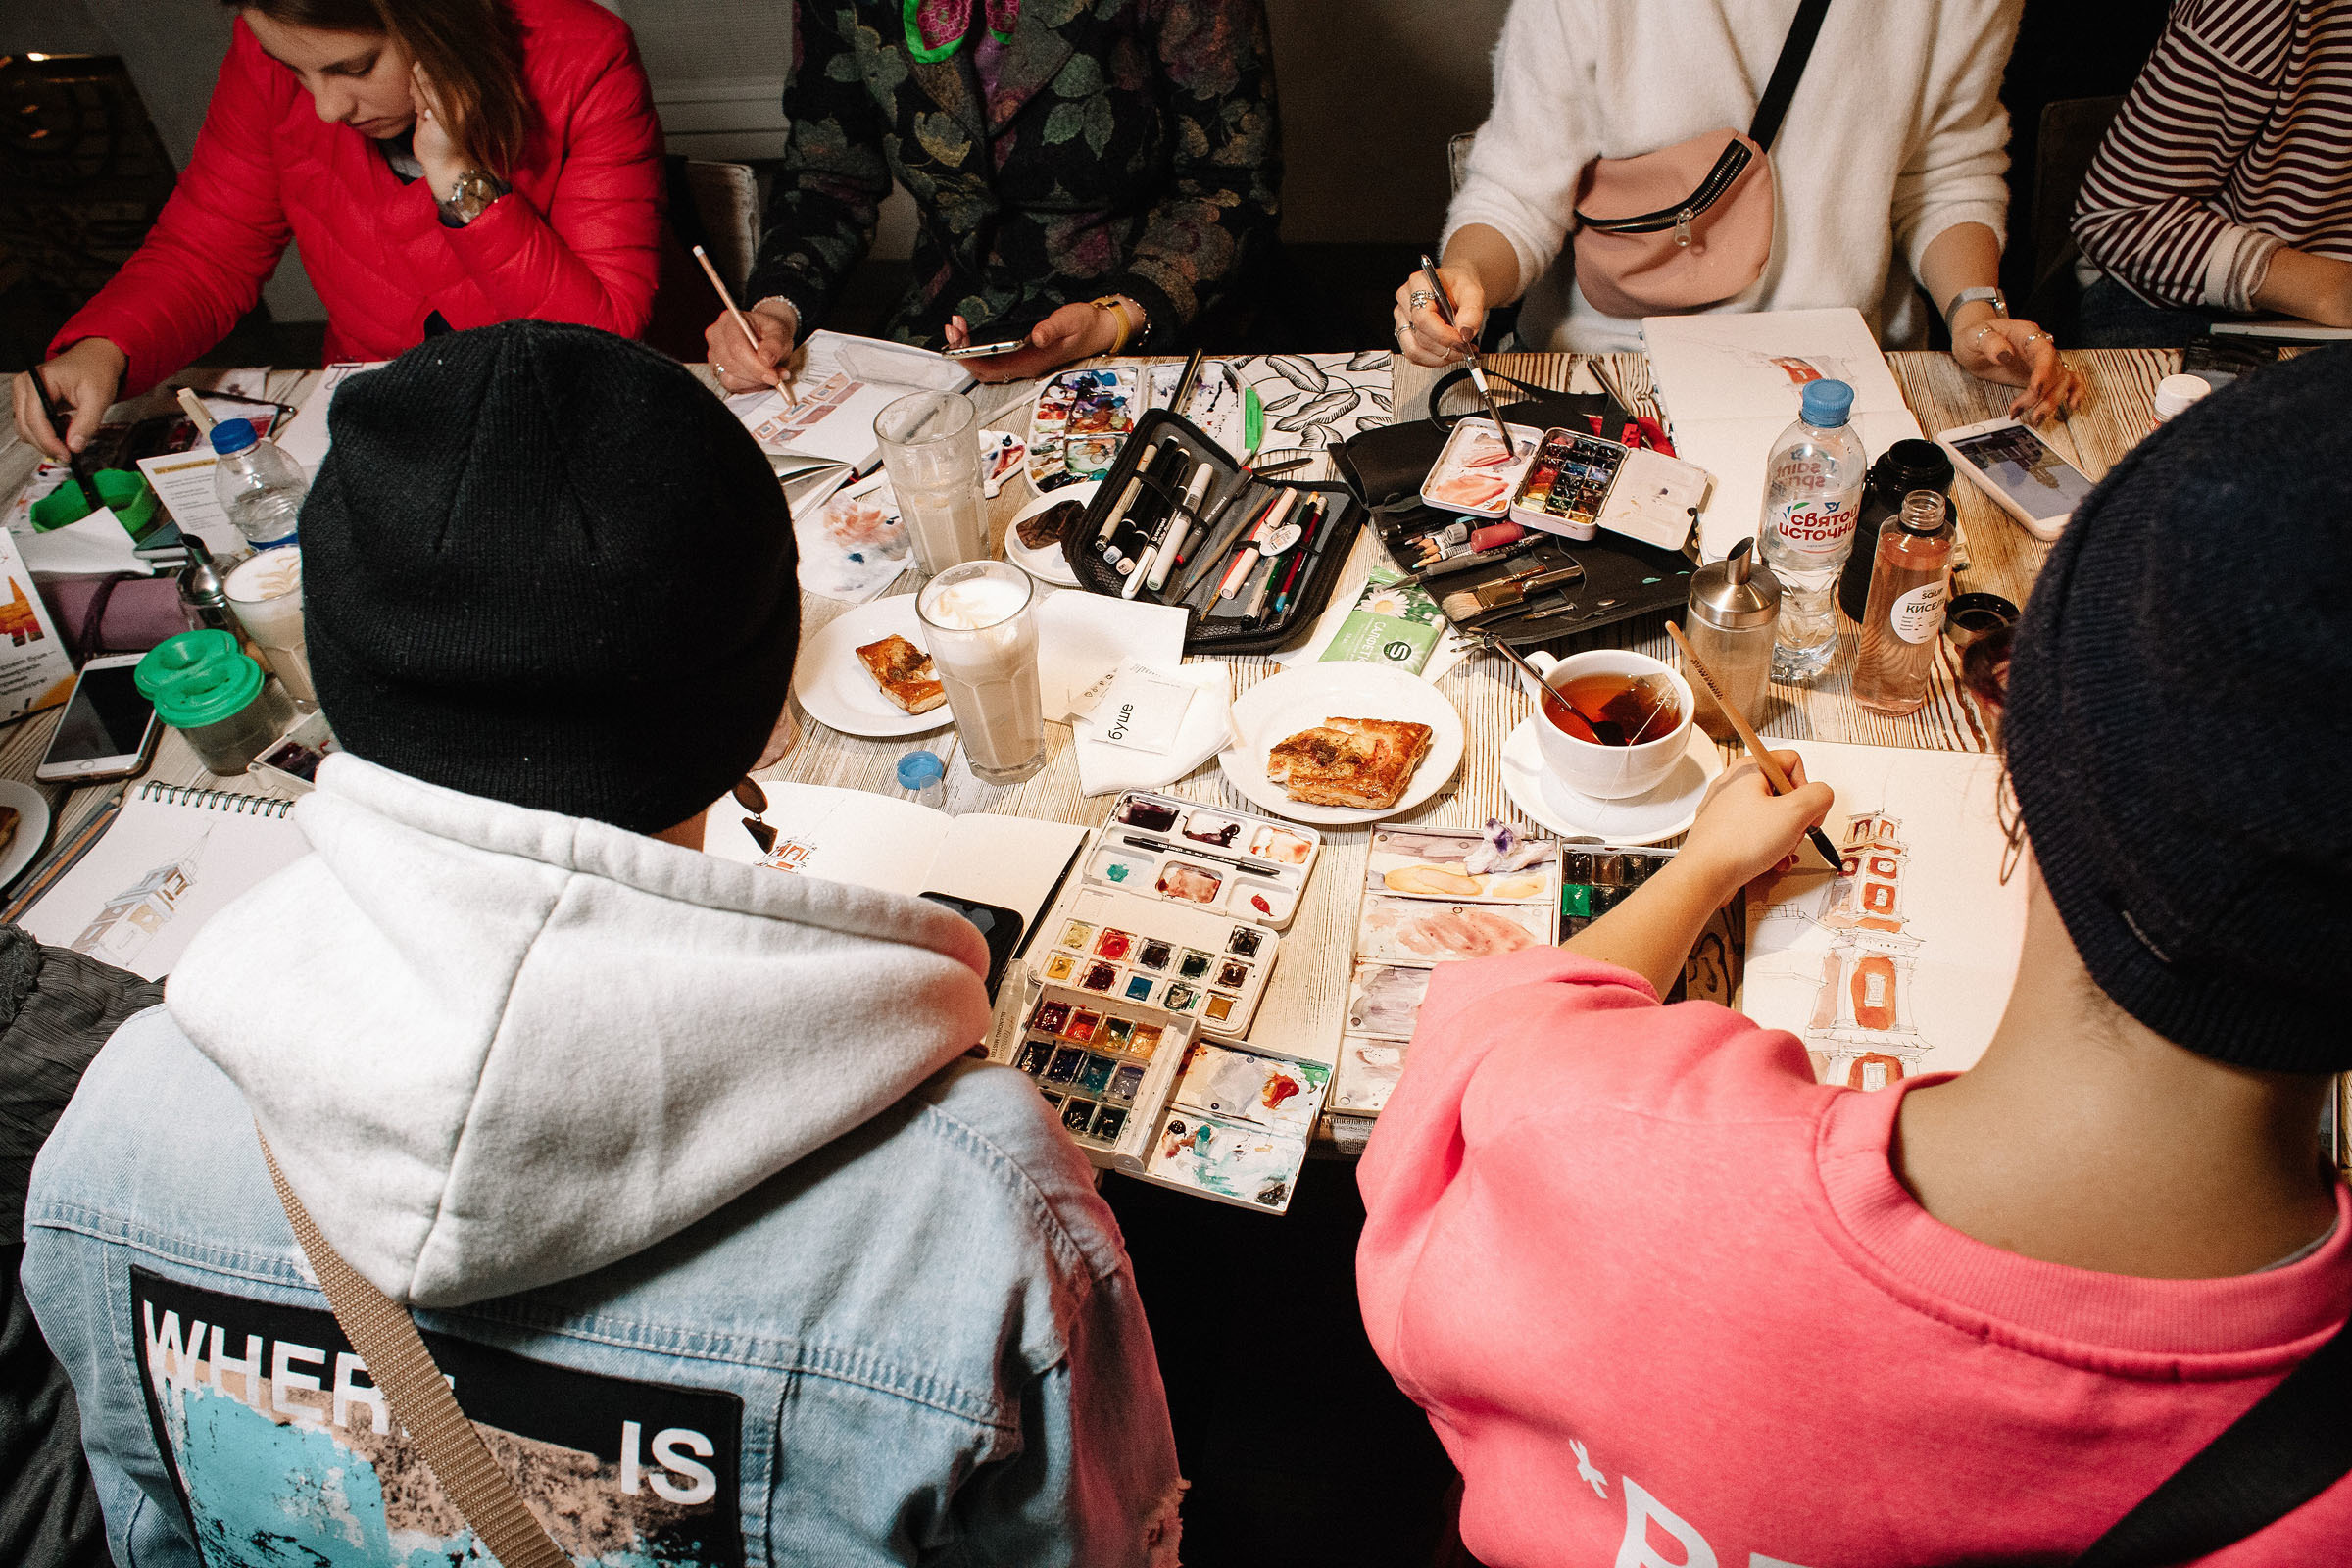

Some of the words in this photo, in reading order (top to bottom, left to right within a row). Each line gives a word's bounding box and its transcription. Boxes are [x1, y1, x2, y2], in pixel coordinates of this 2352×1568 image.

[1108, 704, 1134, 740] буше
[143, 1299, 455, 1438] WHER
[620, 1420, 717, 1505] IS
